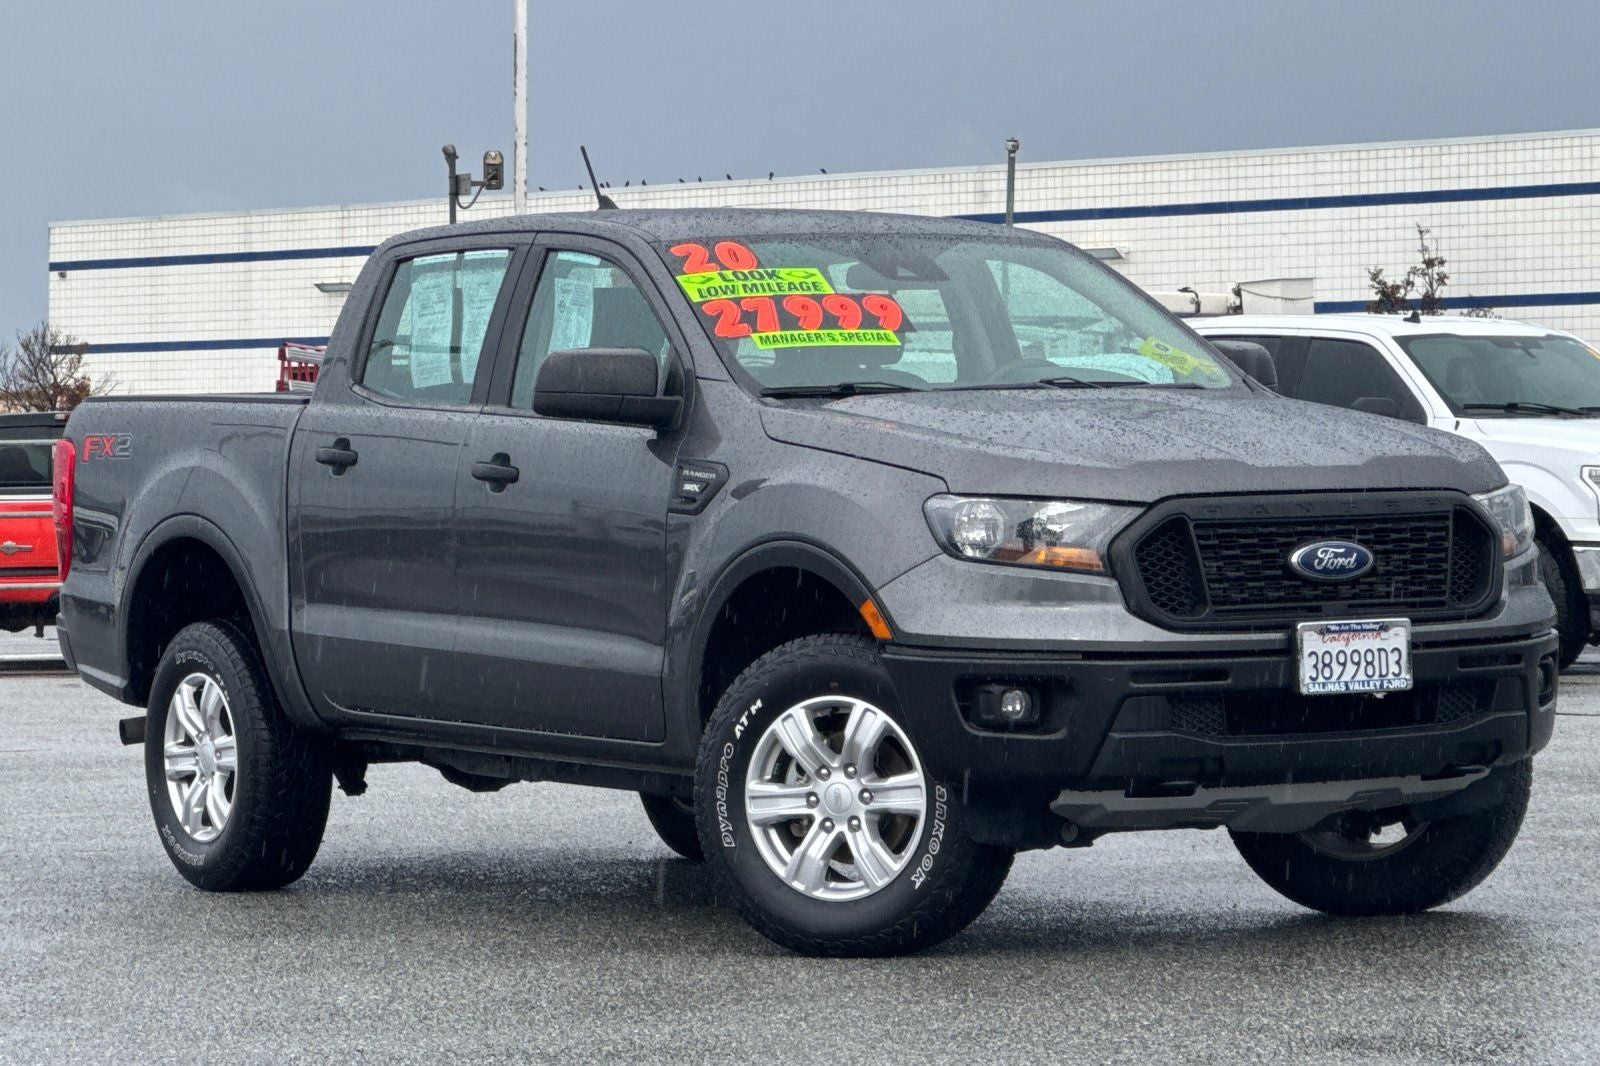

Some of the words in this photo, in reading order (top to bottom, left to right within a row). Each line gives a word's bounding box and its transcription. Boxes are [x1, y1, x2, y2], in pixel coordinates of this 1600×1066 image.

[670, 241, 758, 275] 20
[717, 269, 782, 283] LOOK
[697, 284, 738, 299] LOW
[742, 281, 825, 294] MILEAGE
[701, 294, 903, 338] 27999
[759, 332, 838, 346] MANAGER'S
[839, 332, 896, 344] SPECIAL
[81, 433, 134, 464] FX2
[682, 469, 717, 479] RANGER
[1313, 547, 1358, 570] Ford
[1307, 647, 1403, 682] 38998D3
[1347, 680, 1381, 691] VALLEY
